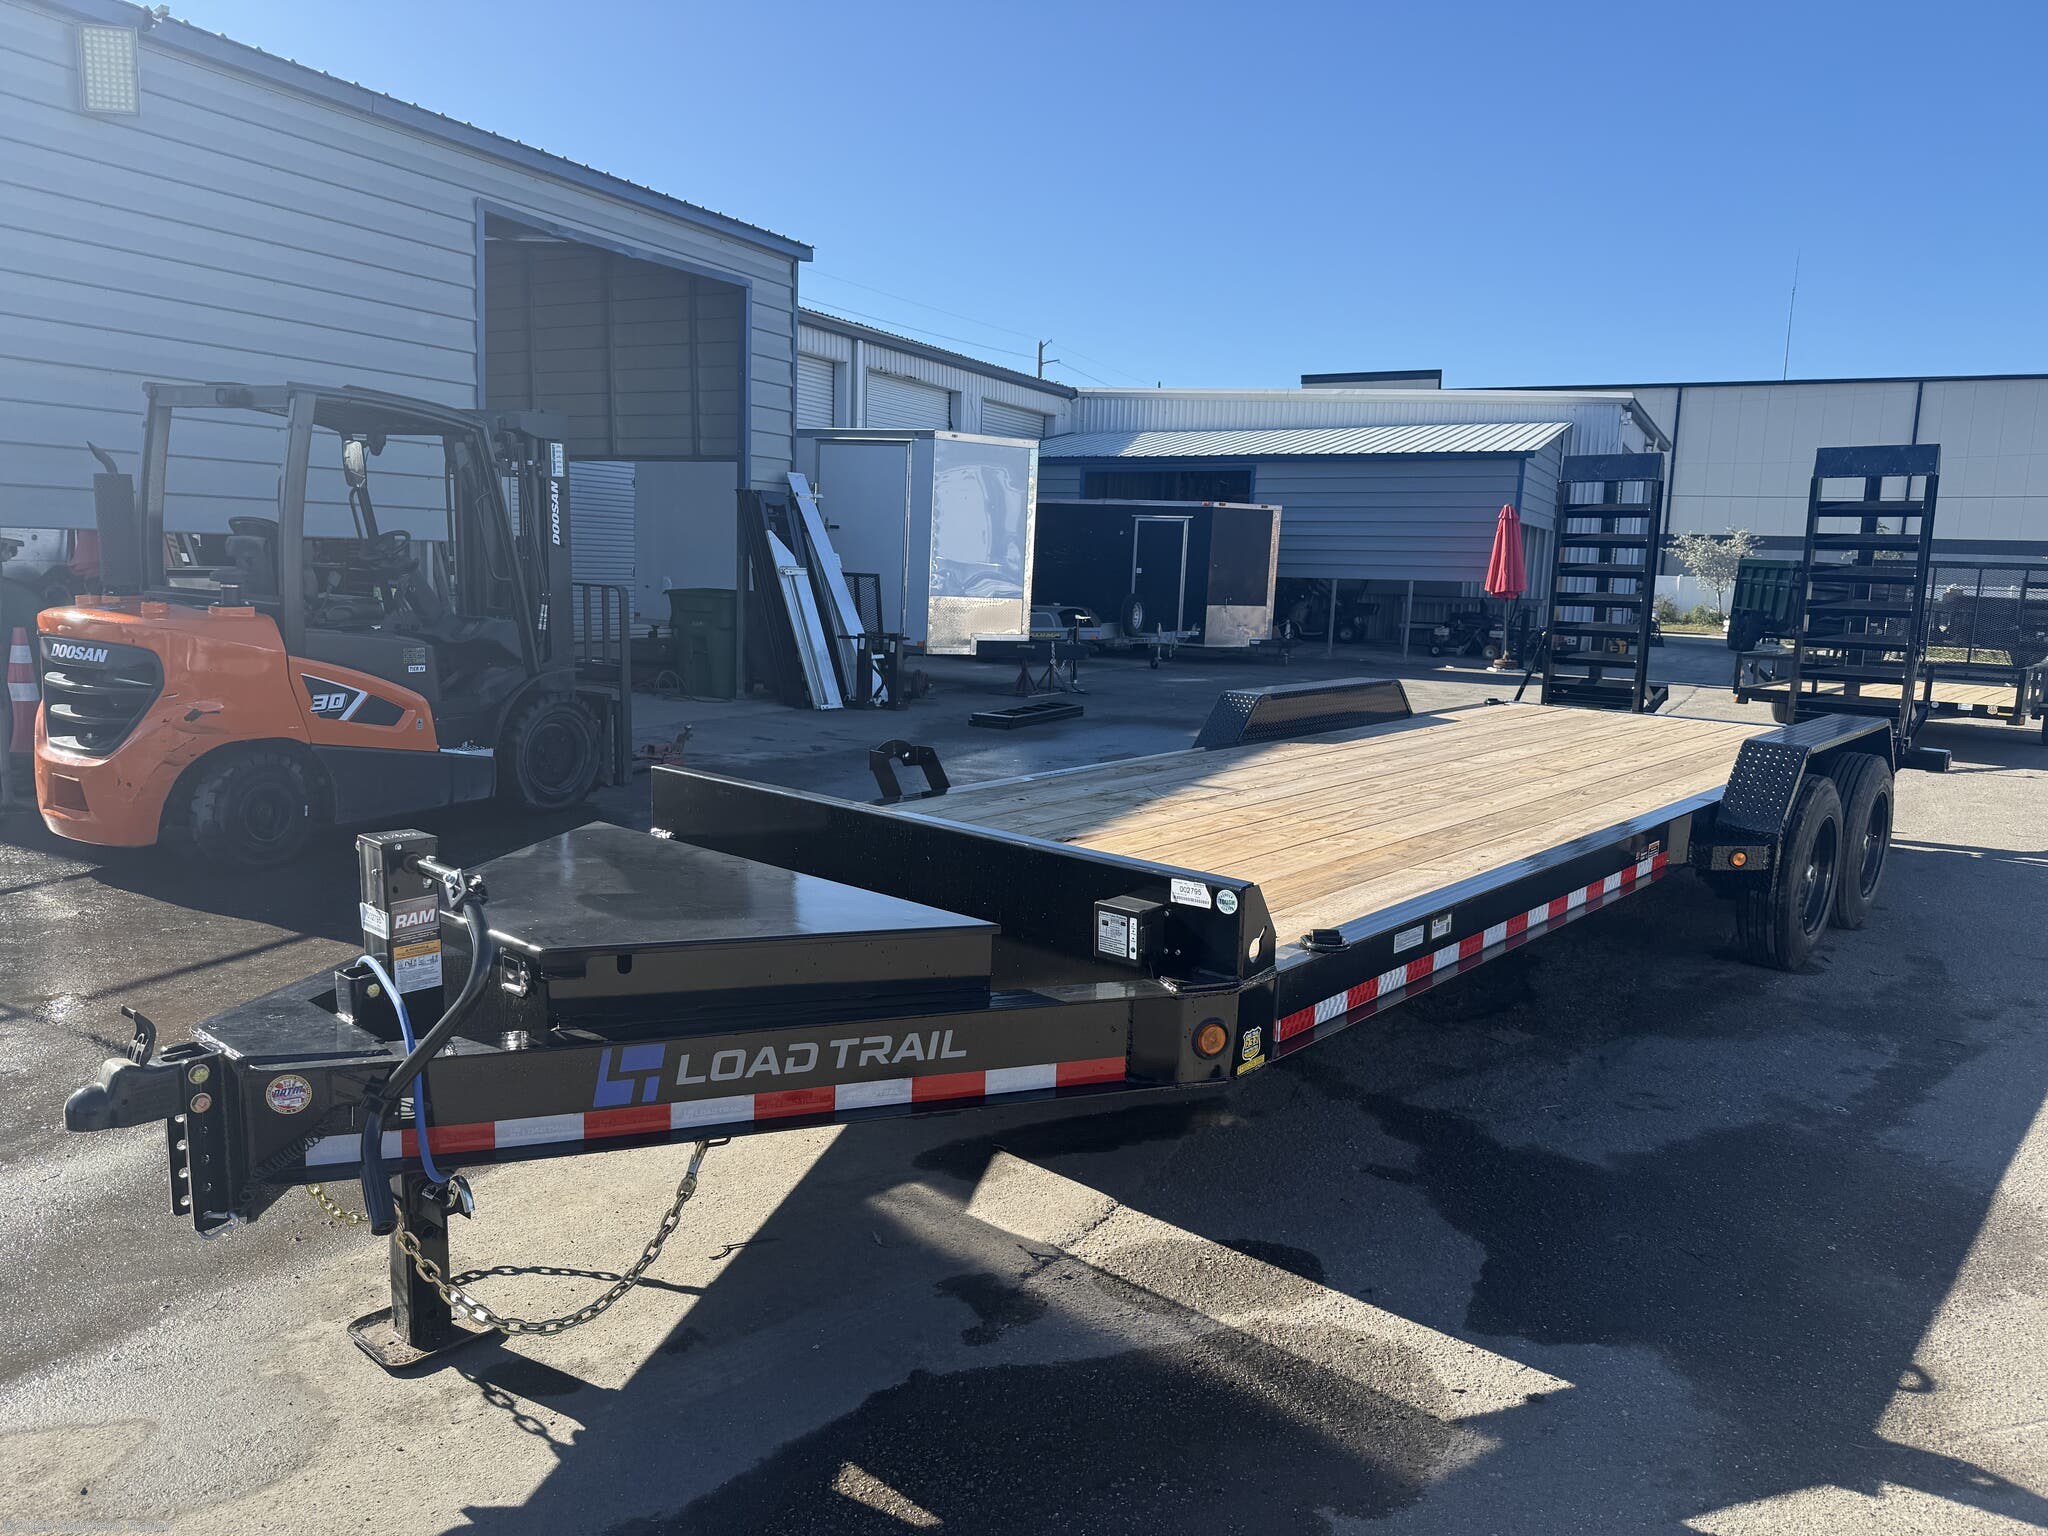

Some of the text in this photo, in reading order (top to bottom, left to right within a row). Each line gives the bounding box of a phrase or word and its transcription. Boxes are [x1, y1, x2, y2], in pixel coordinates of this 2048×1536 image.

[550, 480, 561, 546] DOOSAN
[51, 643, 108, 663] DOOSAN
[310, 693, 347, 713] 30
[394, 908, 436, 929] RAM
[675, 1029, 967, 1086] LOAD TRAIL
